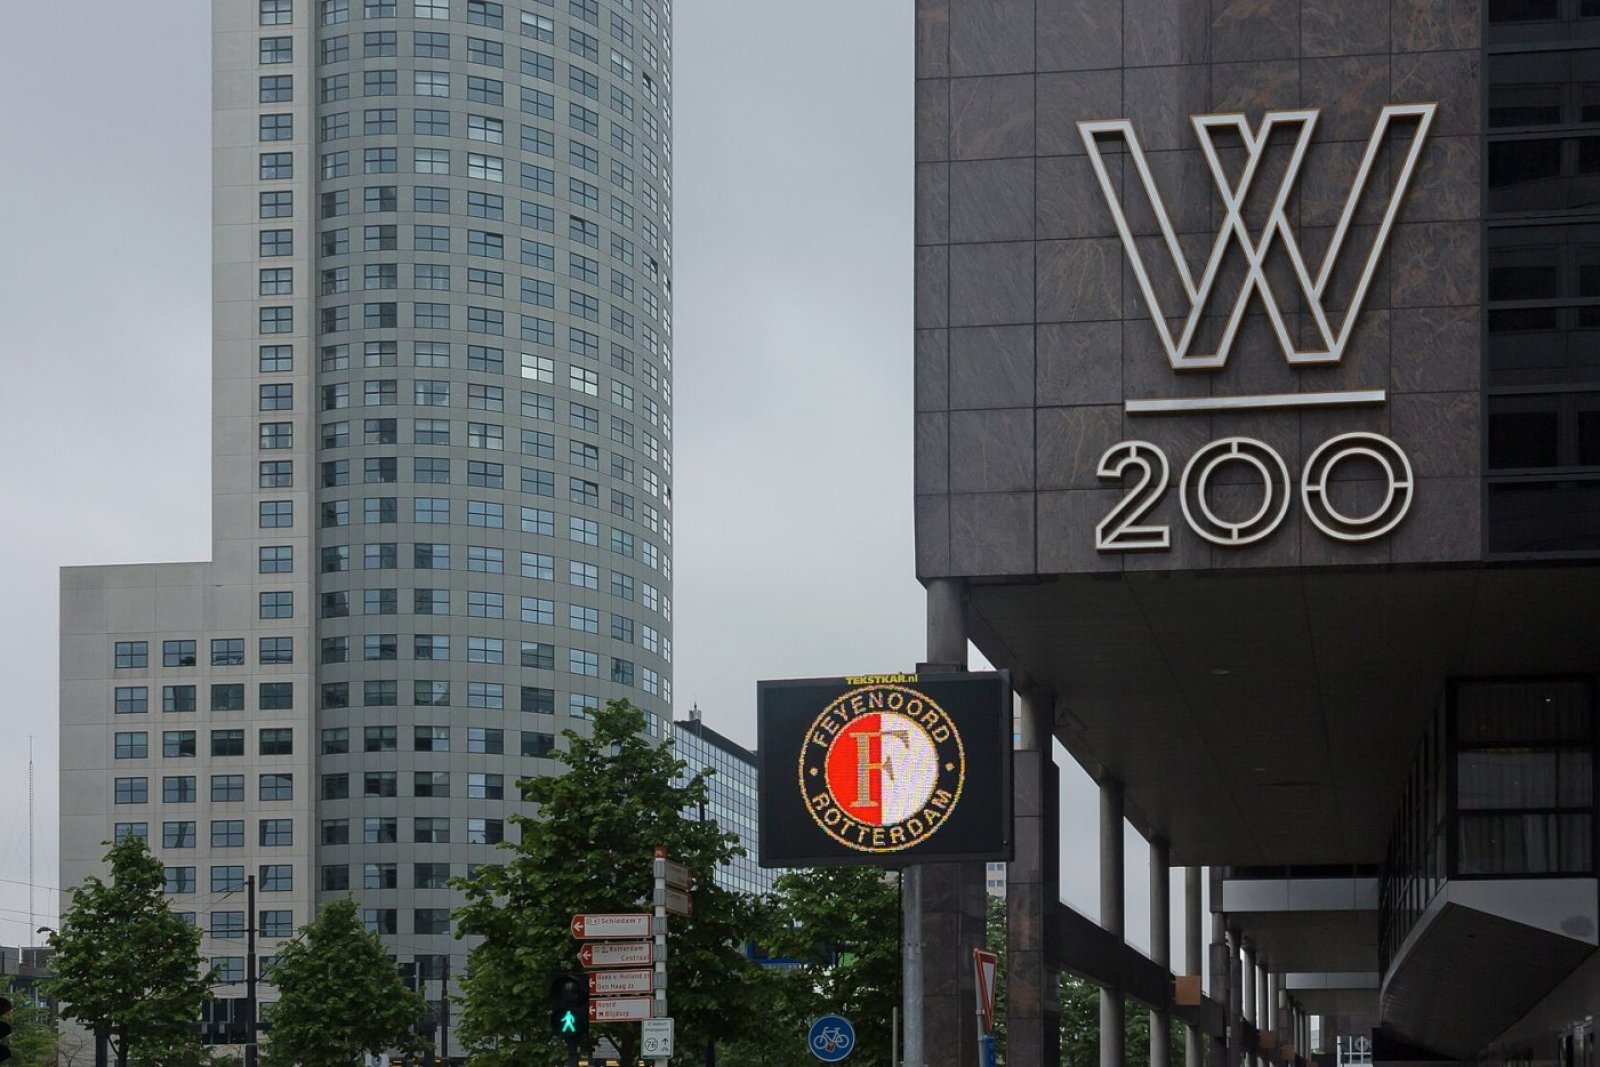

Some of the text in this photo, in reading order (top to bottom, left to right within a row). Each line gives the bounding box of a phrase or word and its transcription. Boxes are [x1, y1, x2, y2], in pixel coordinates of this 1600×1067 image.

[1095, 431, 1414, 551] 200
[845, 673, 919, 686] TEKSTKAR.nl
[813, 693, 949, 748] FEYENOORD
[812, 789, 952, 846] ROTTERDAM
[601, 917, 636, 925] Schiedam
[609, 945, 644, 953] Rotterdam
